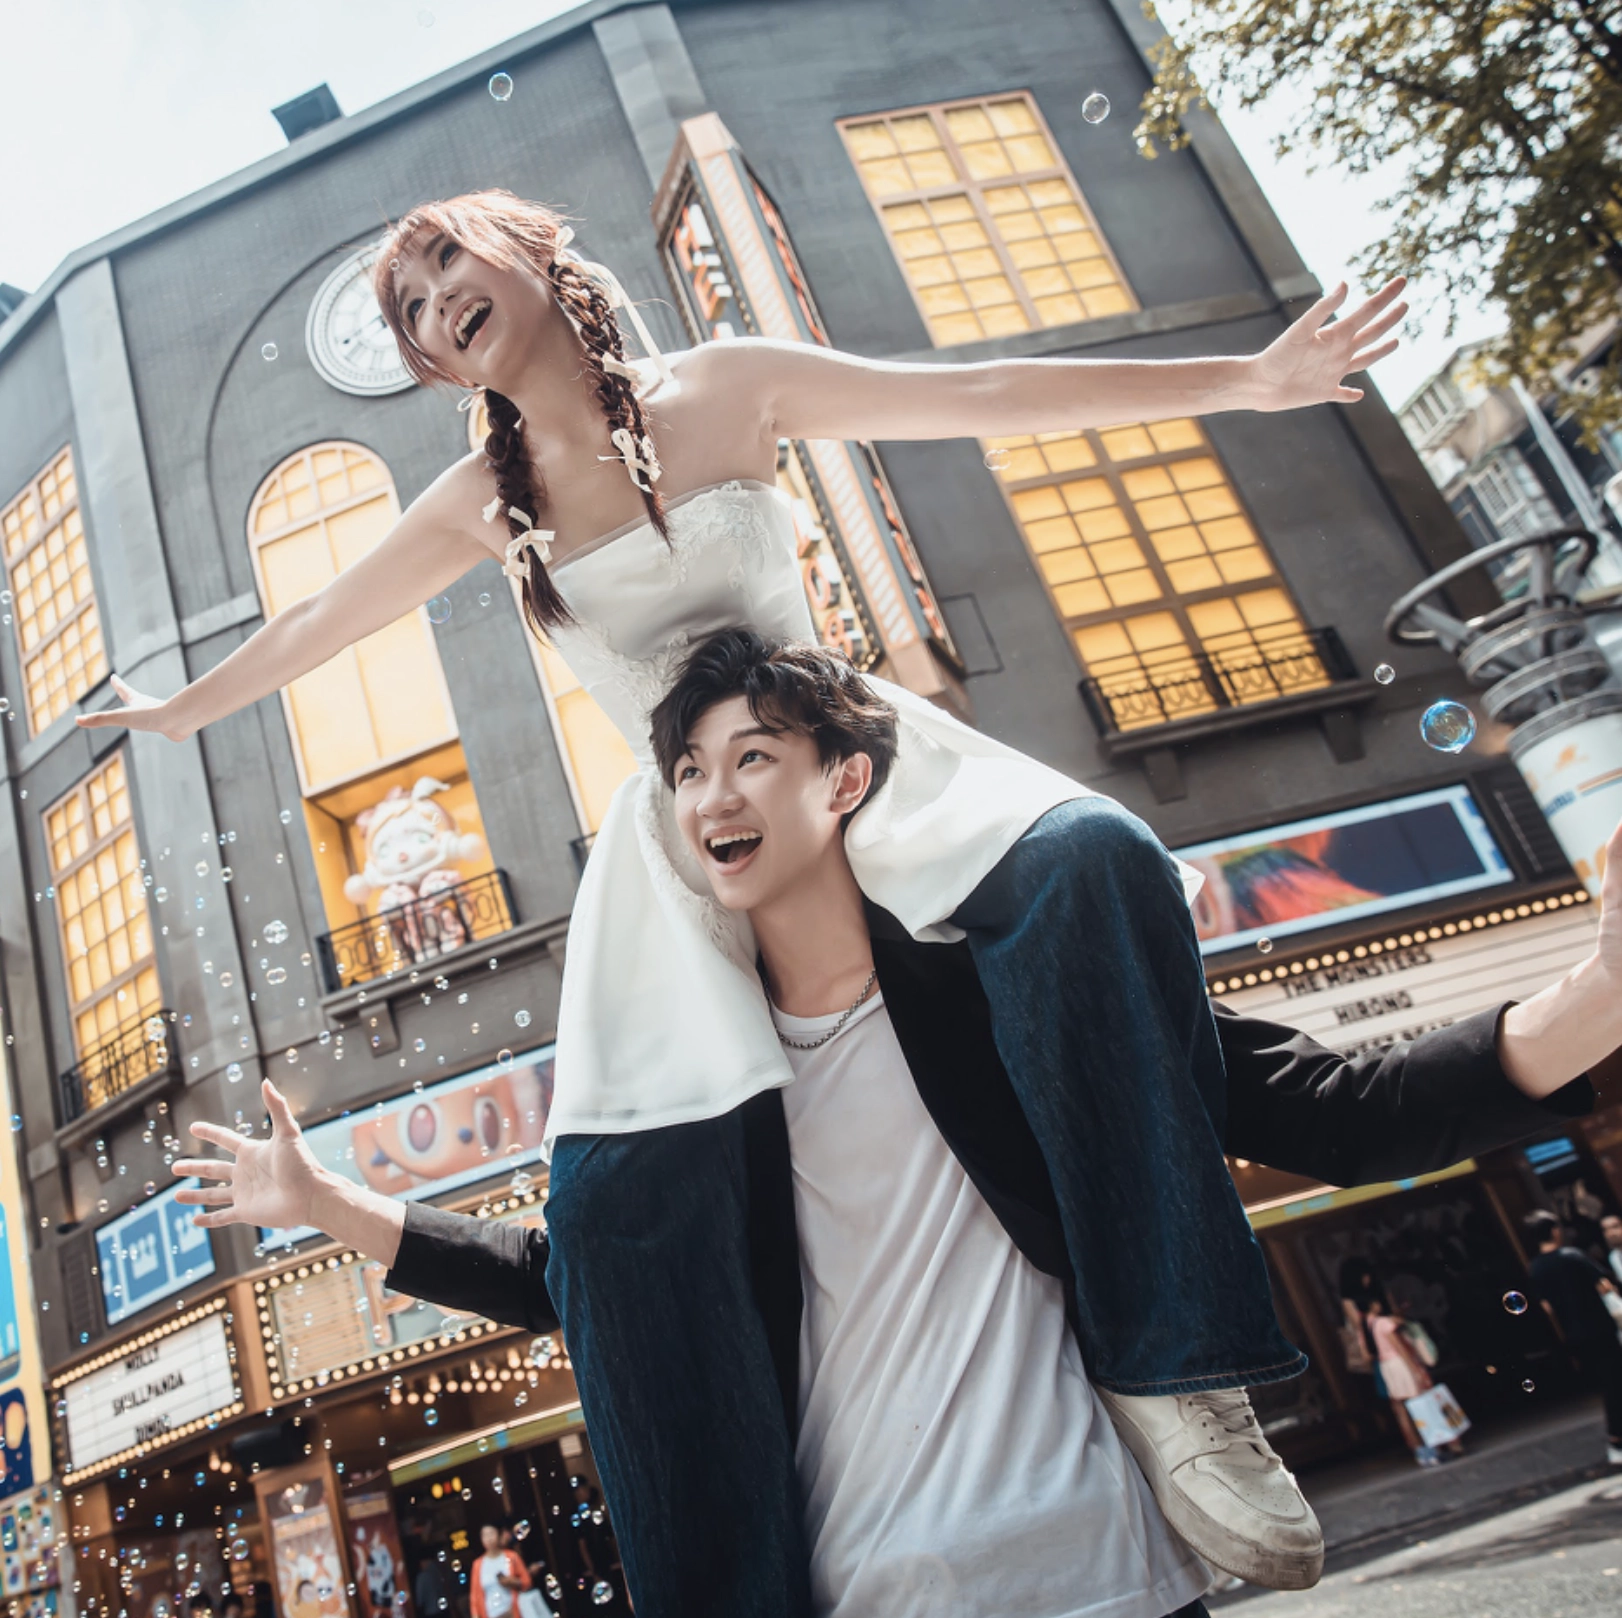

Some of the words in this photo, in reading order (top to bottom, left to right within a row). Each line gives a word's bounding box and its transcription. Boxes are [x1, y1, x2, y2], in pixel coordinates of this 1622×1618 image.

[1279, 973, 1322, 999] THE
[1324, 946, 1433, 988] MONSTERS
[1333, 988, 1414, 1026] HIRONO
